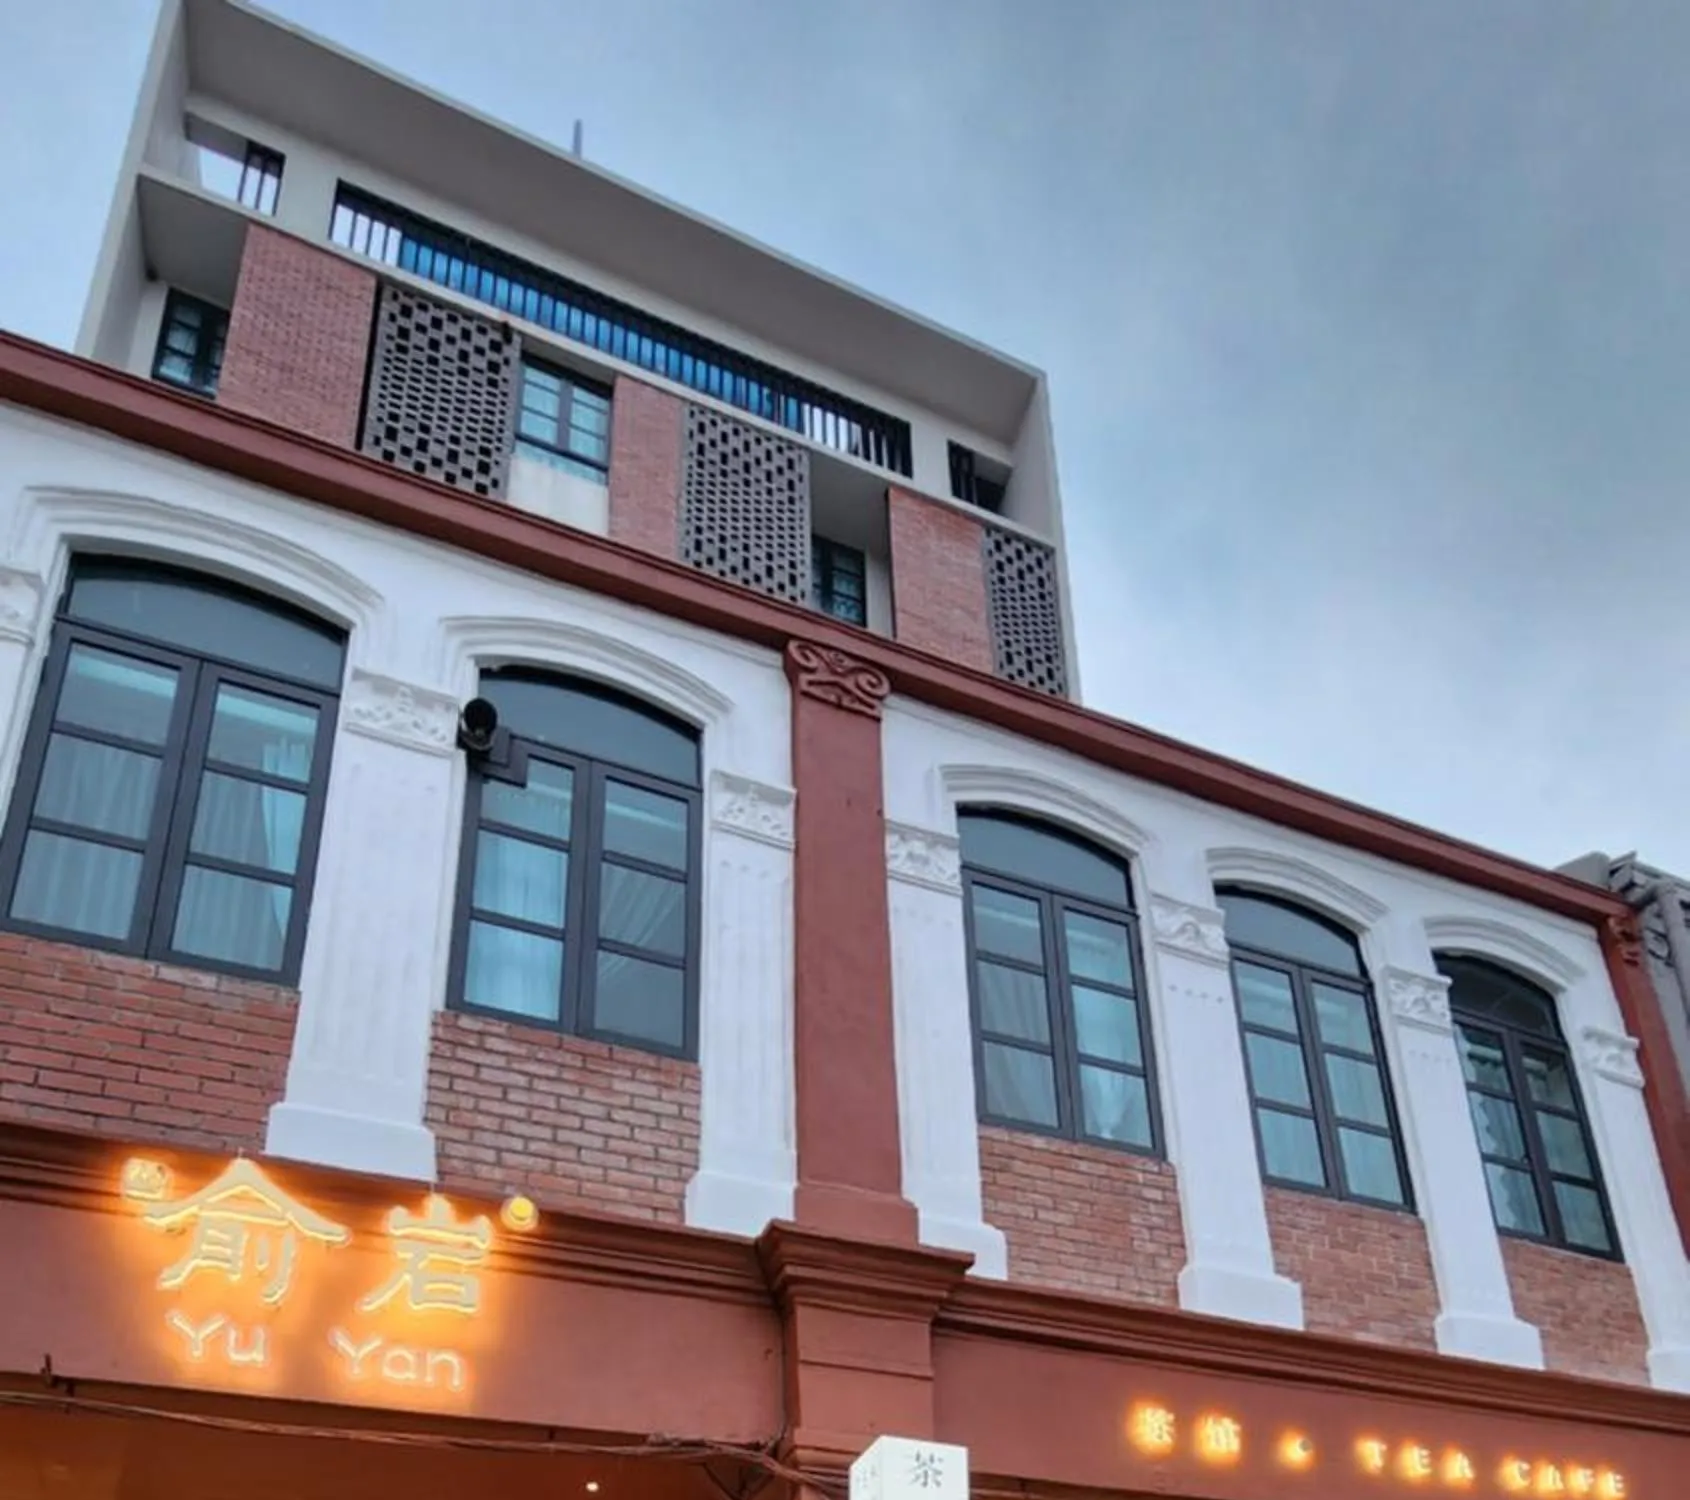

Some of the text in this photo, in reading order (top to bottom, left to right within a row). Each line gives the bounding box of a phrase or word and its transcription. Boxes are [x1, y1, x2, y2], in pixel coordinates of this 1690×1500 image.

[168, 1310, 466, 1391] Yu Yan
[908, 1449, 945, 1488] 茶
[1355, 1438, 1625, 1499] TEA CAFE
